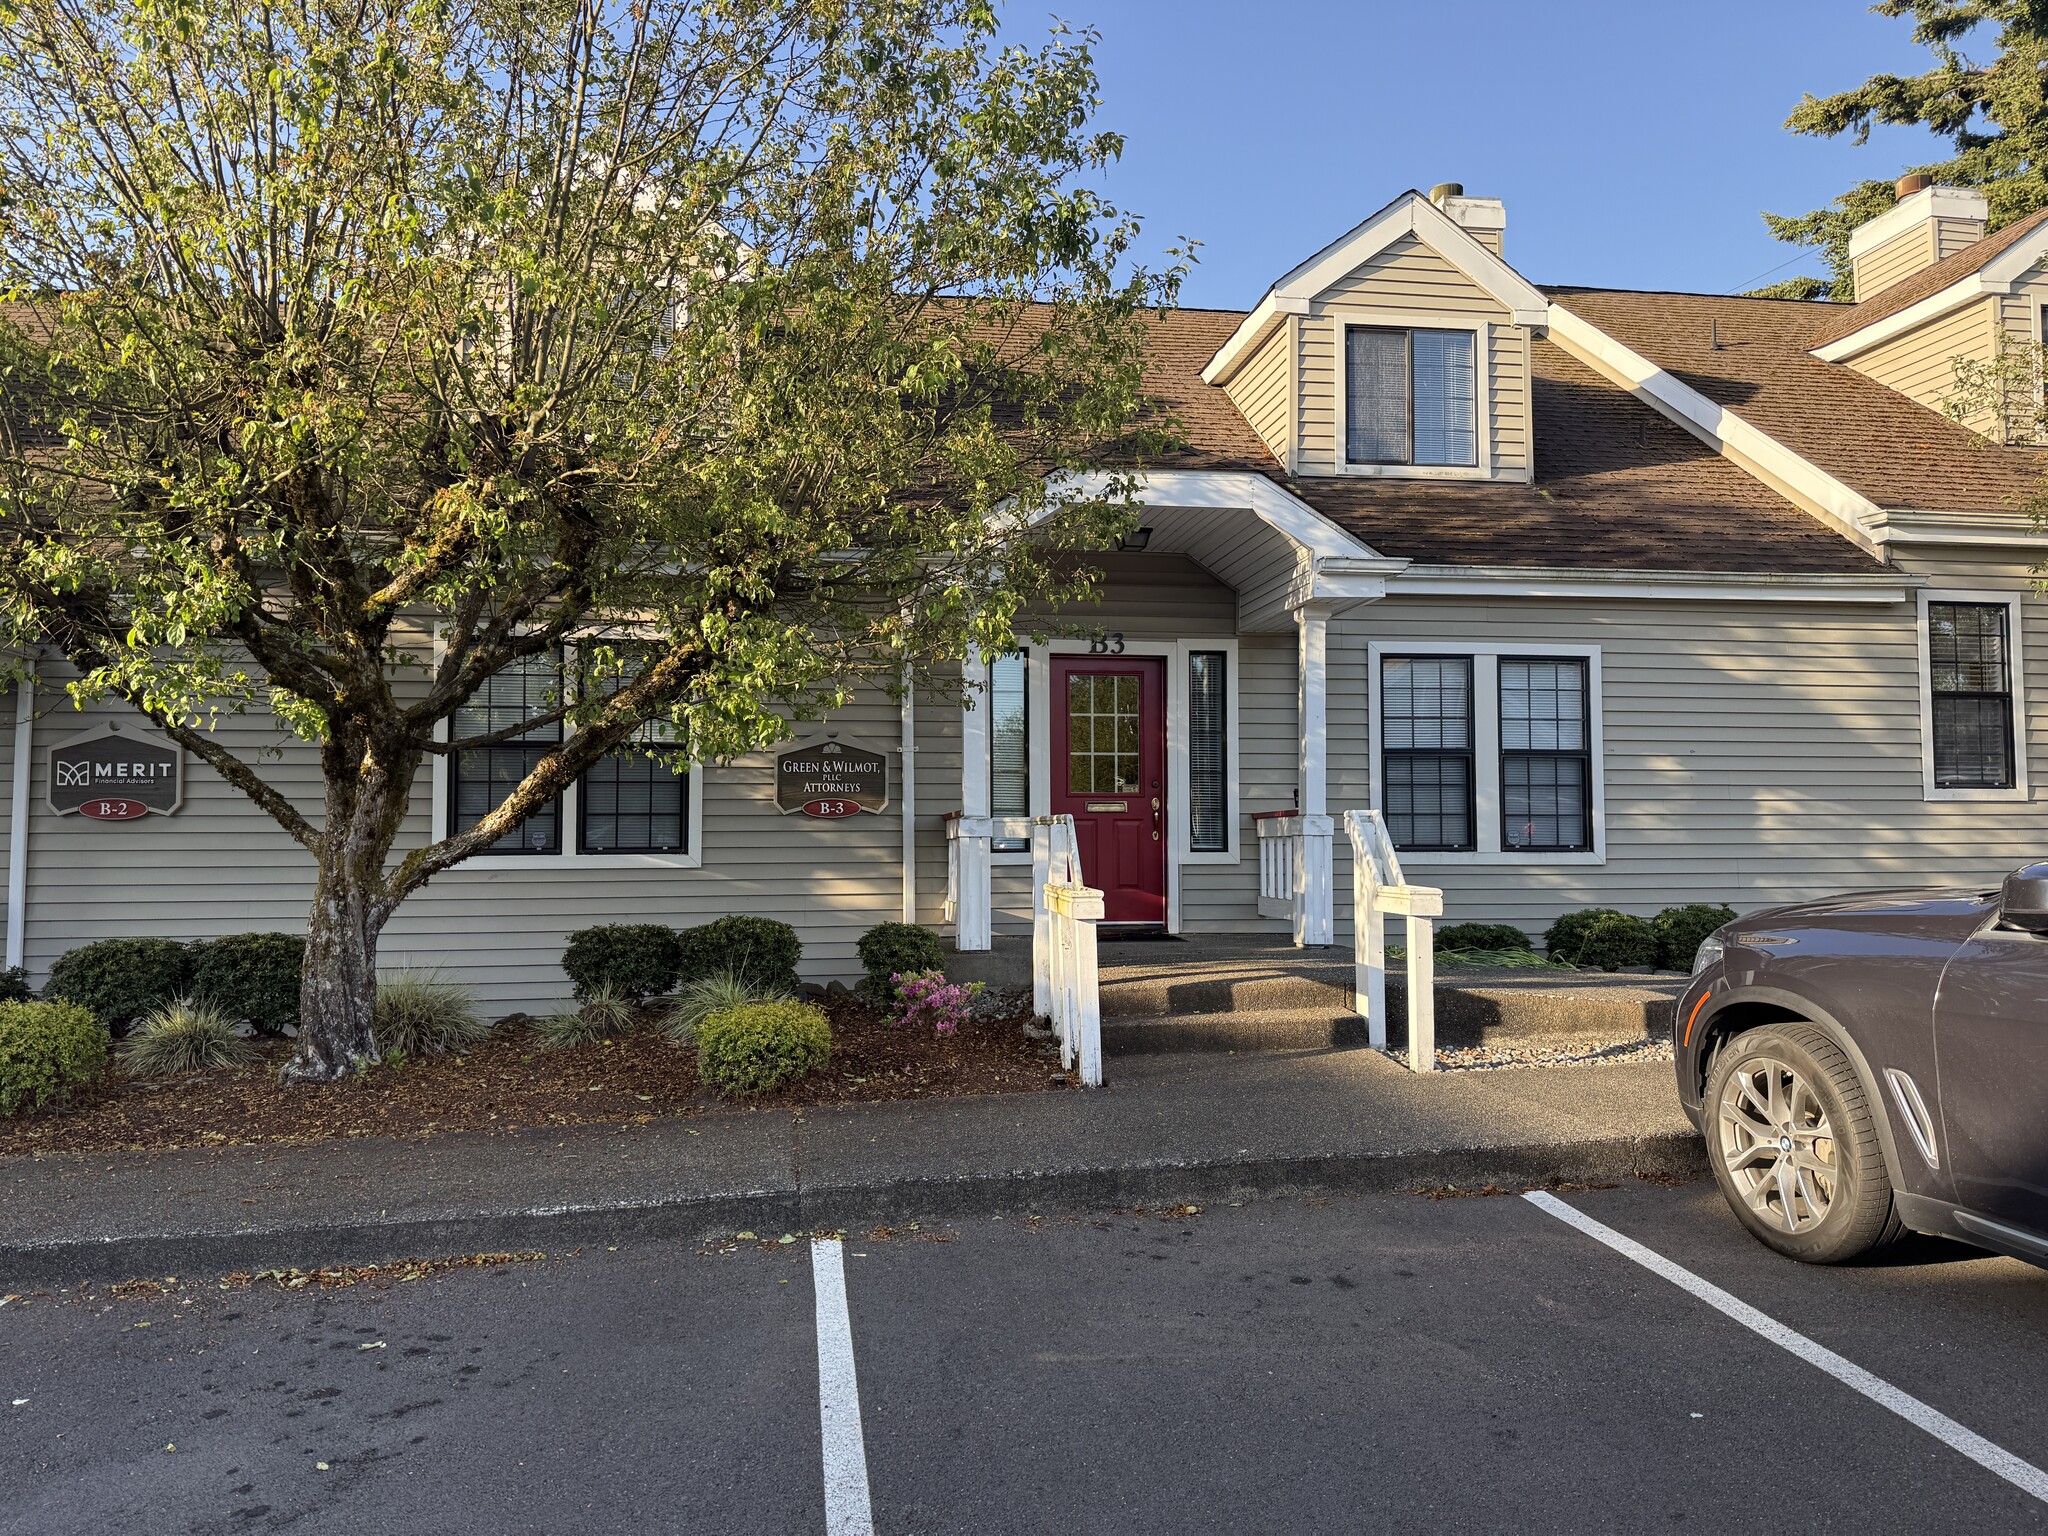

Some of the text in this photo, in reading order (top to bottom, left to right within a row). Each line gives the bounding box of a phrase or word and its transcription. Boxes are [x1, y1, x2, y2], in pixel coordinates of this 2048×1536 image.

[1088, 632, 1125, 654] B3
[95, 763, 172, 777] MERIT
[783, 760, 880, 774] GREEN & WILMOT,
[803, 782, 861, 793] ATTORNEYS
[99, 802, 128, 815] B-2
[819, 802, 844, 814] B-3
